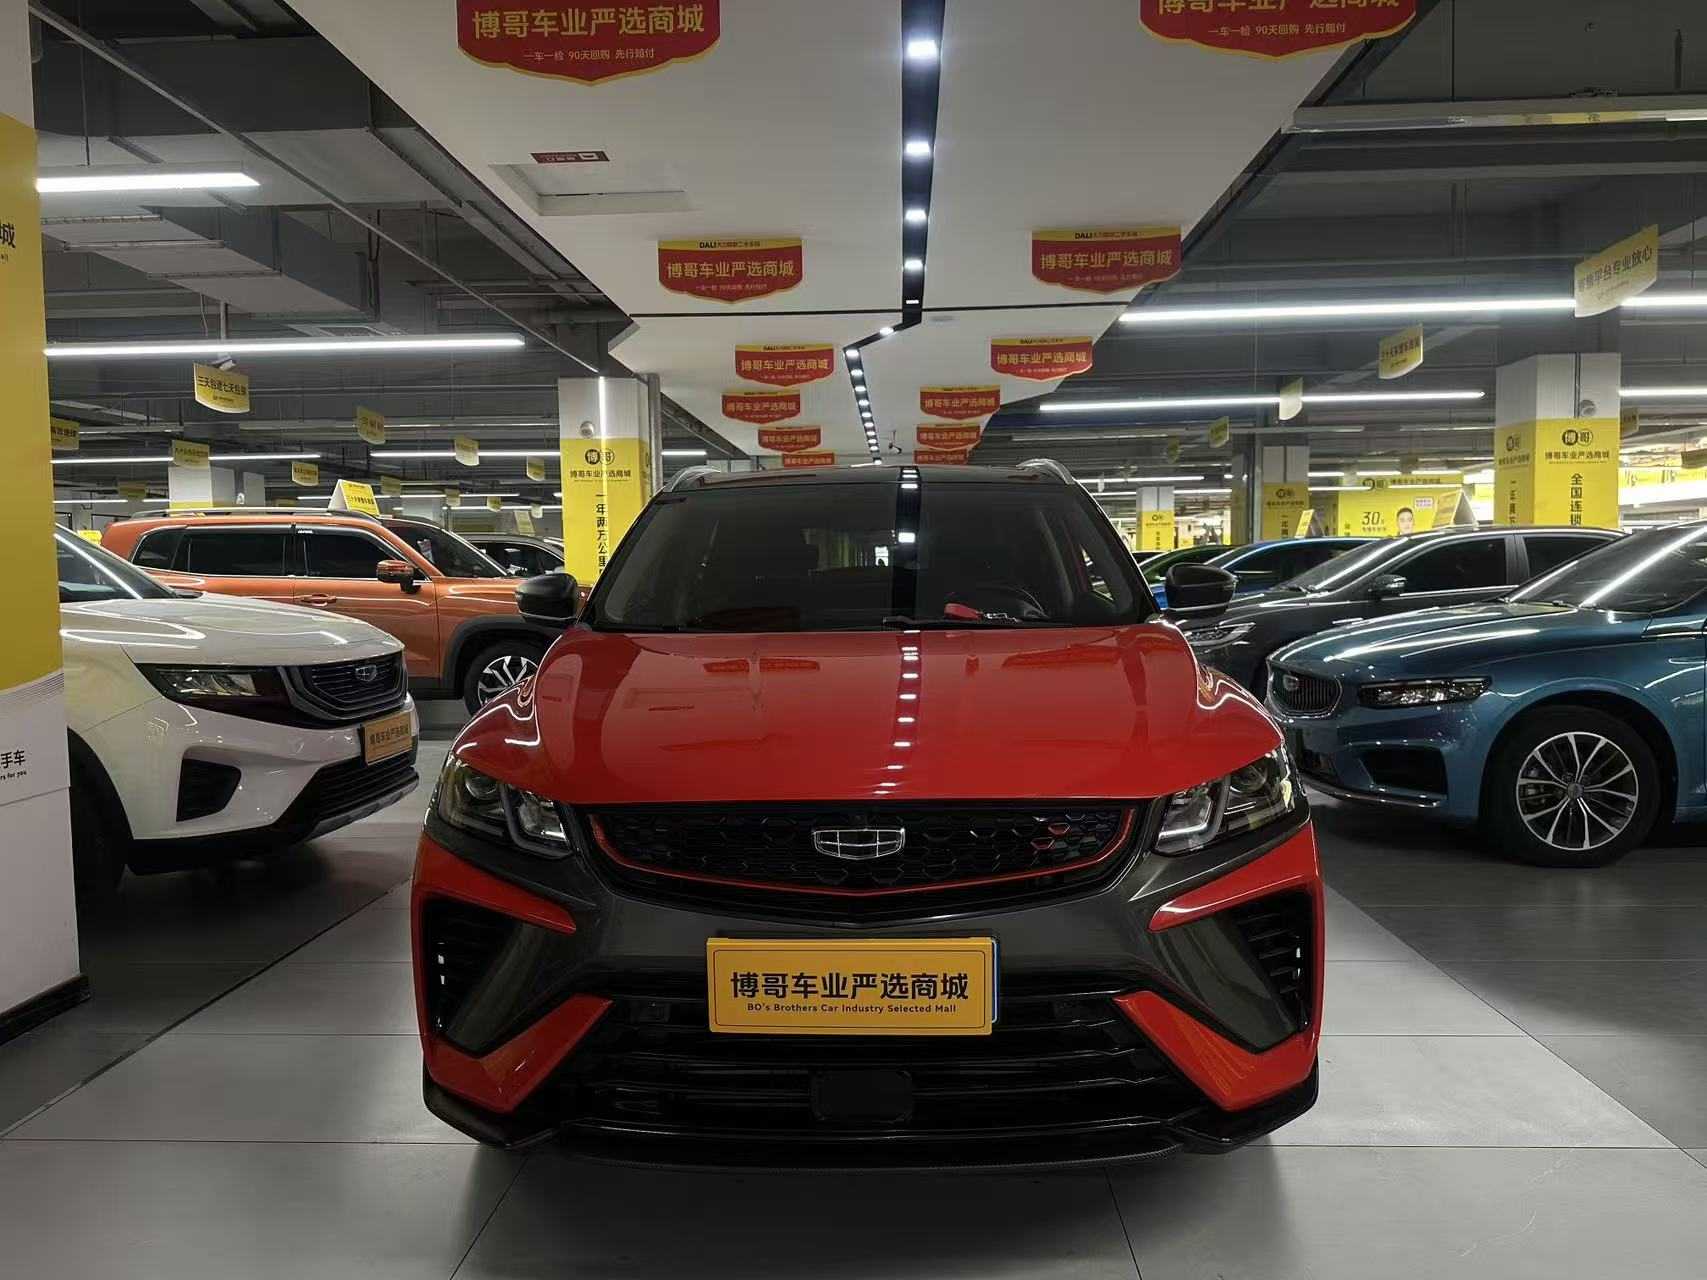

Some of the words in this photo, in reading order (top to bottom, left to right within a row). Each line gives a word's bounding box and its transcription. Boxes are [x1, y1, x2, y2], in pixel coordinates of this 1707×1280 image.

[472, 4, 704, 39] 博哥车业严选商城
[523, 52, 564, 61] 一车一检
[699, 241, 717, 249] DALI
[667, 260, 795, 279] 博哥车业严选商城
[1040, 250, 1172, 270] 博哥车业严选商城
[1570, 472, 1583, 526] 全国连锁
[595, 493, 607, 575] 一年两万公里
[730, 971, 969, 1000] 博哥车业严选商城
[774, 1003, 818, 1013] Brothers
[821, 1004, 838, 1013] Car
[842, 1003, 884, 1014] Industry
[888, 1004, 932, 1014] Selected
[935, 1004, 956, 1014] Mall
